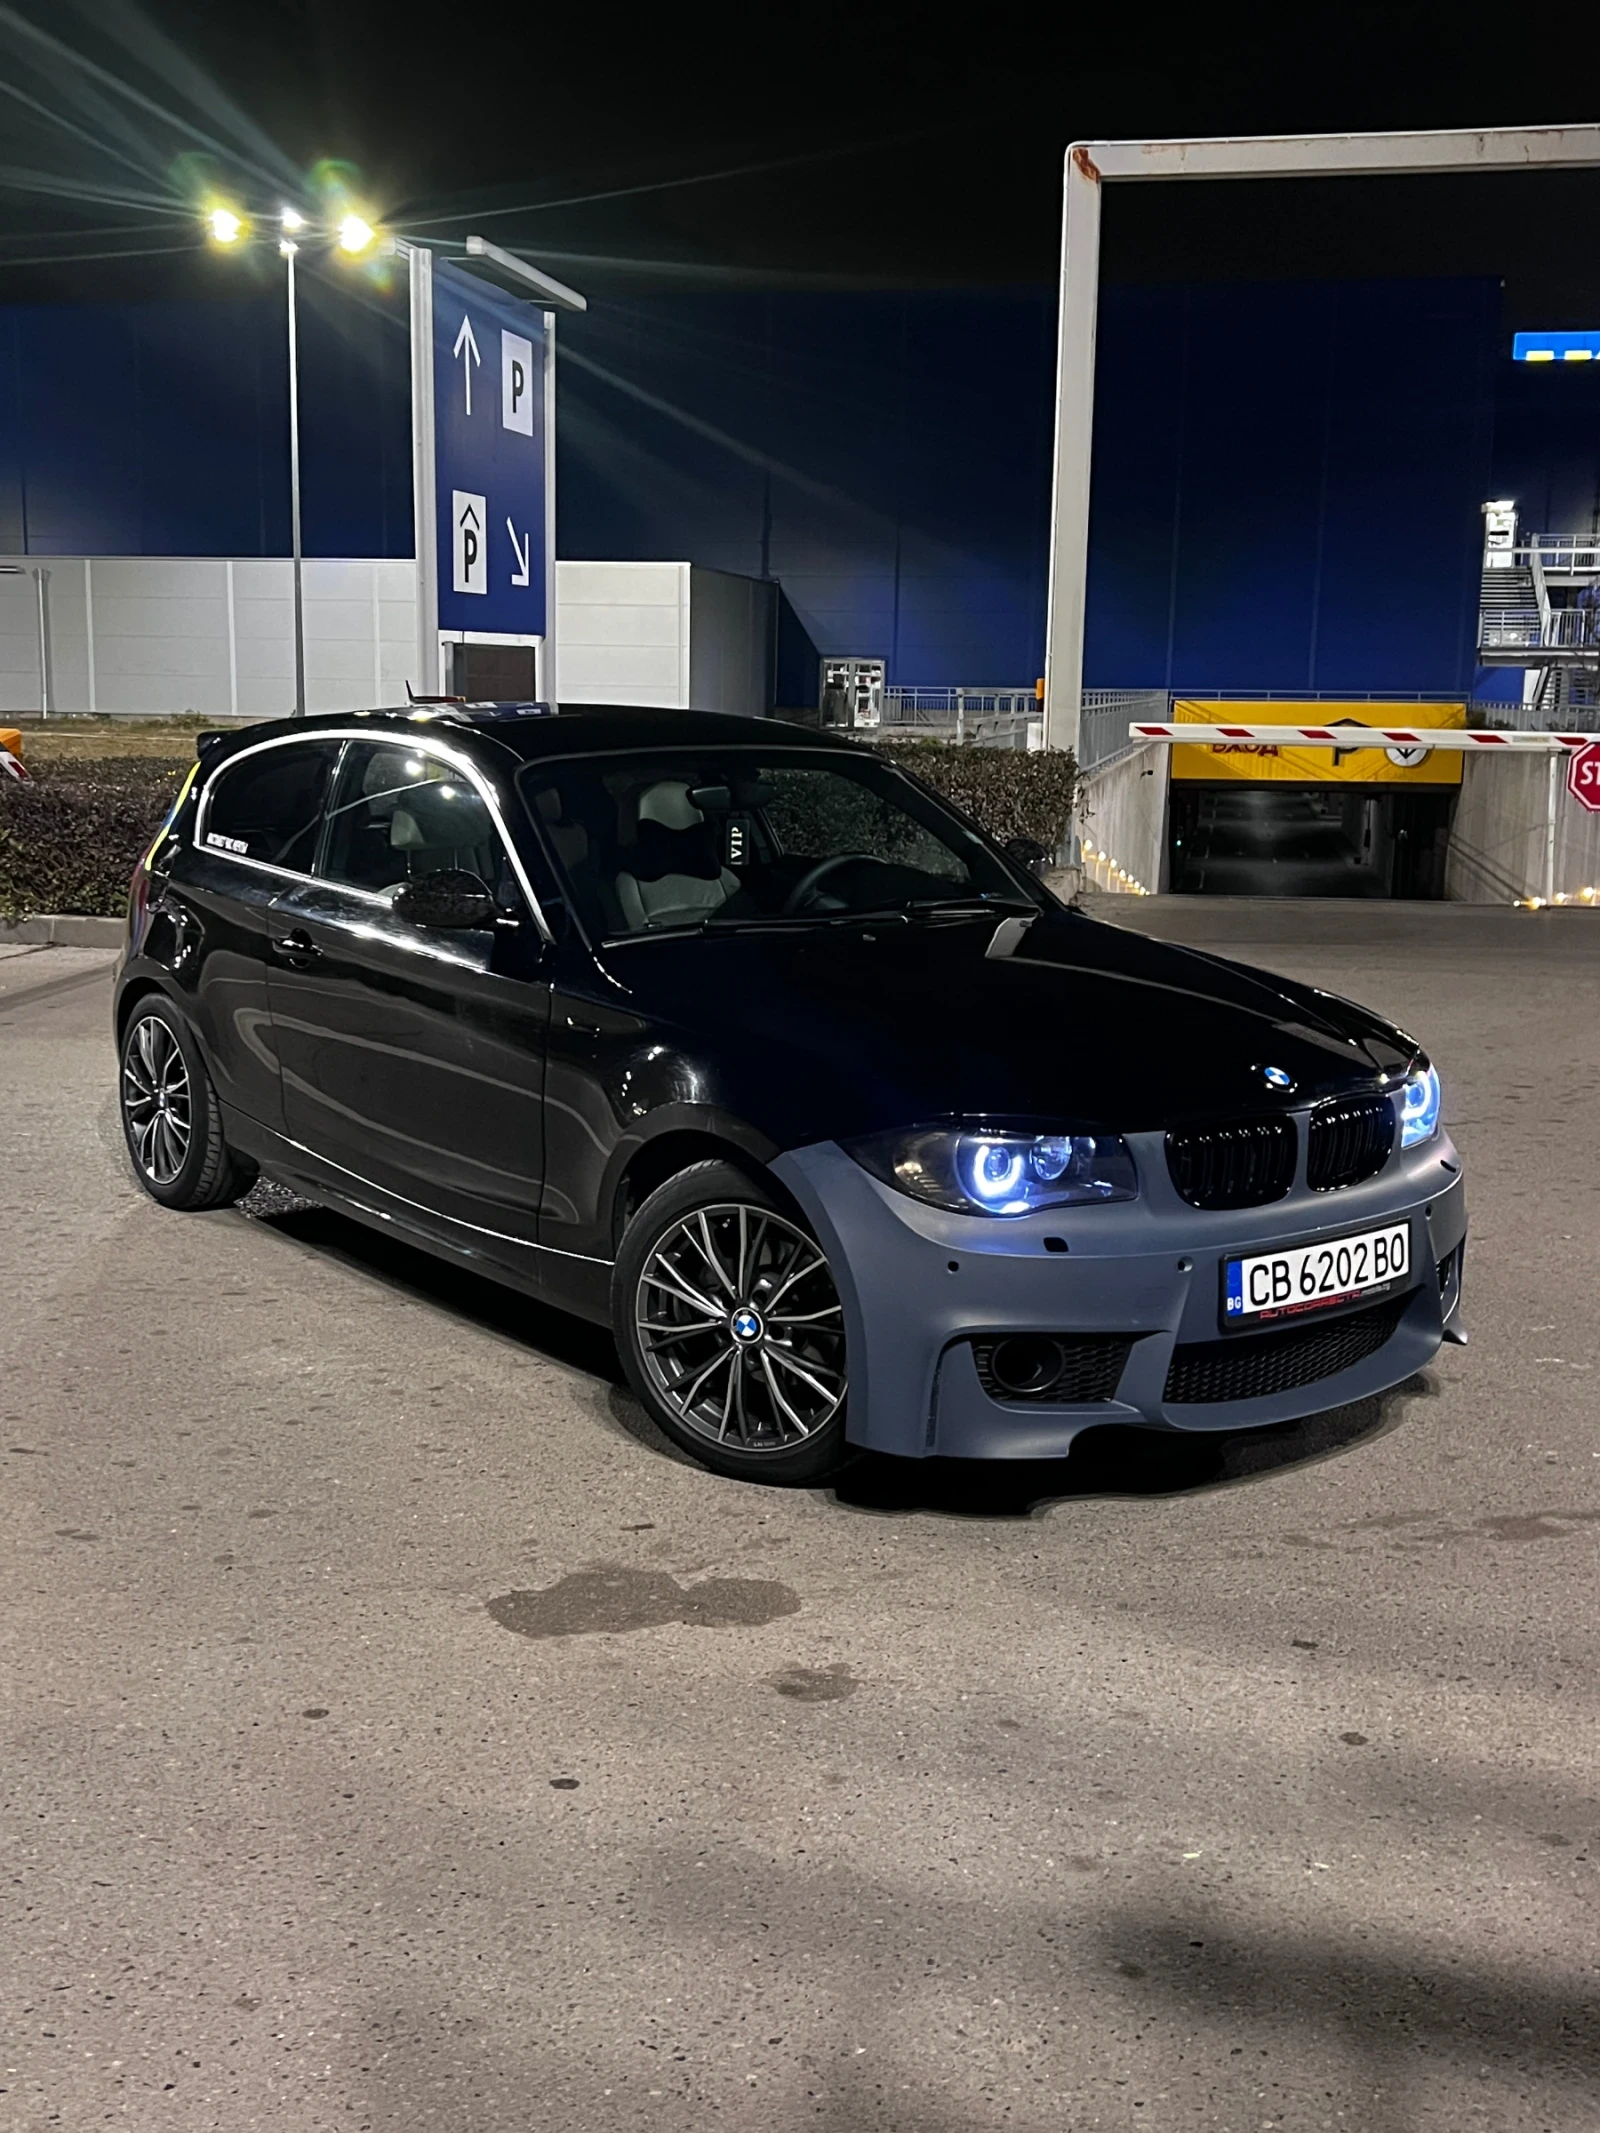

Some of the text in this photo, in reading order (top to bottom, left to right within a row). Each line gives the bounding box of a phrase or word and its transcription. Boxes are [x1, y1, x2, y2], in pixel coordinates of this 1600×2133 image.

[512, 360, 524, 413] P
[464, 529, 477, 583] P
[731, 826, 743, 859] VIP
[1249, 1233, 1405, 1306] CB 6202 BO
[1227, 1297, 1242, 1311] BG
